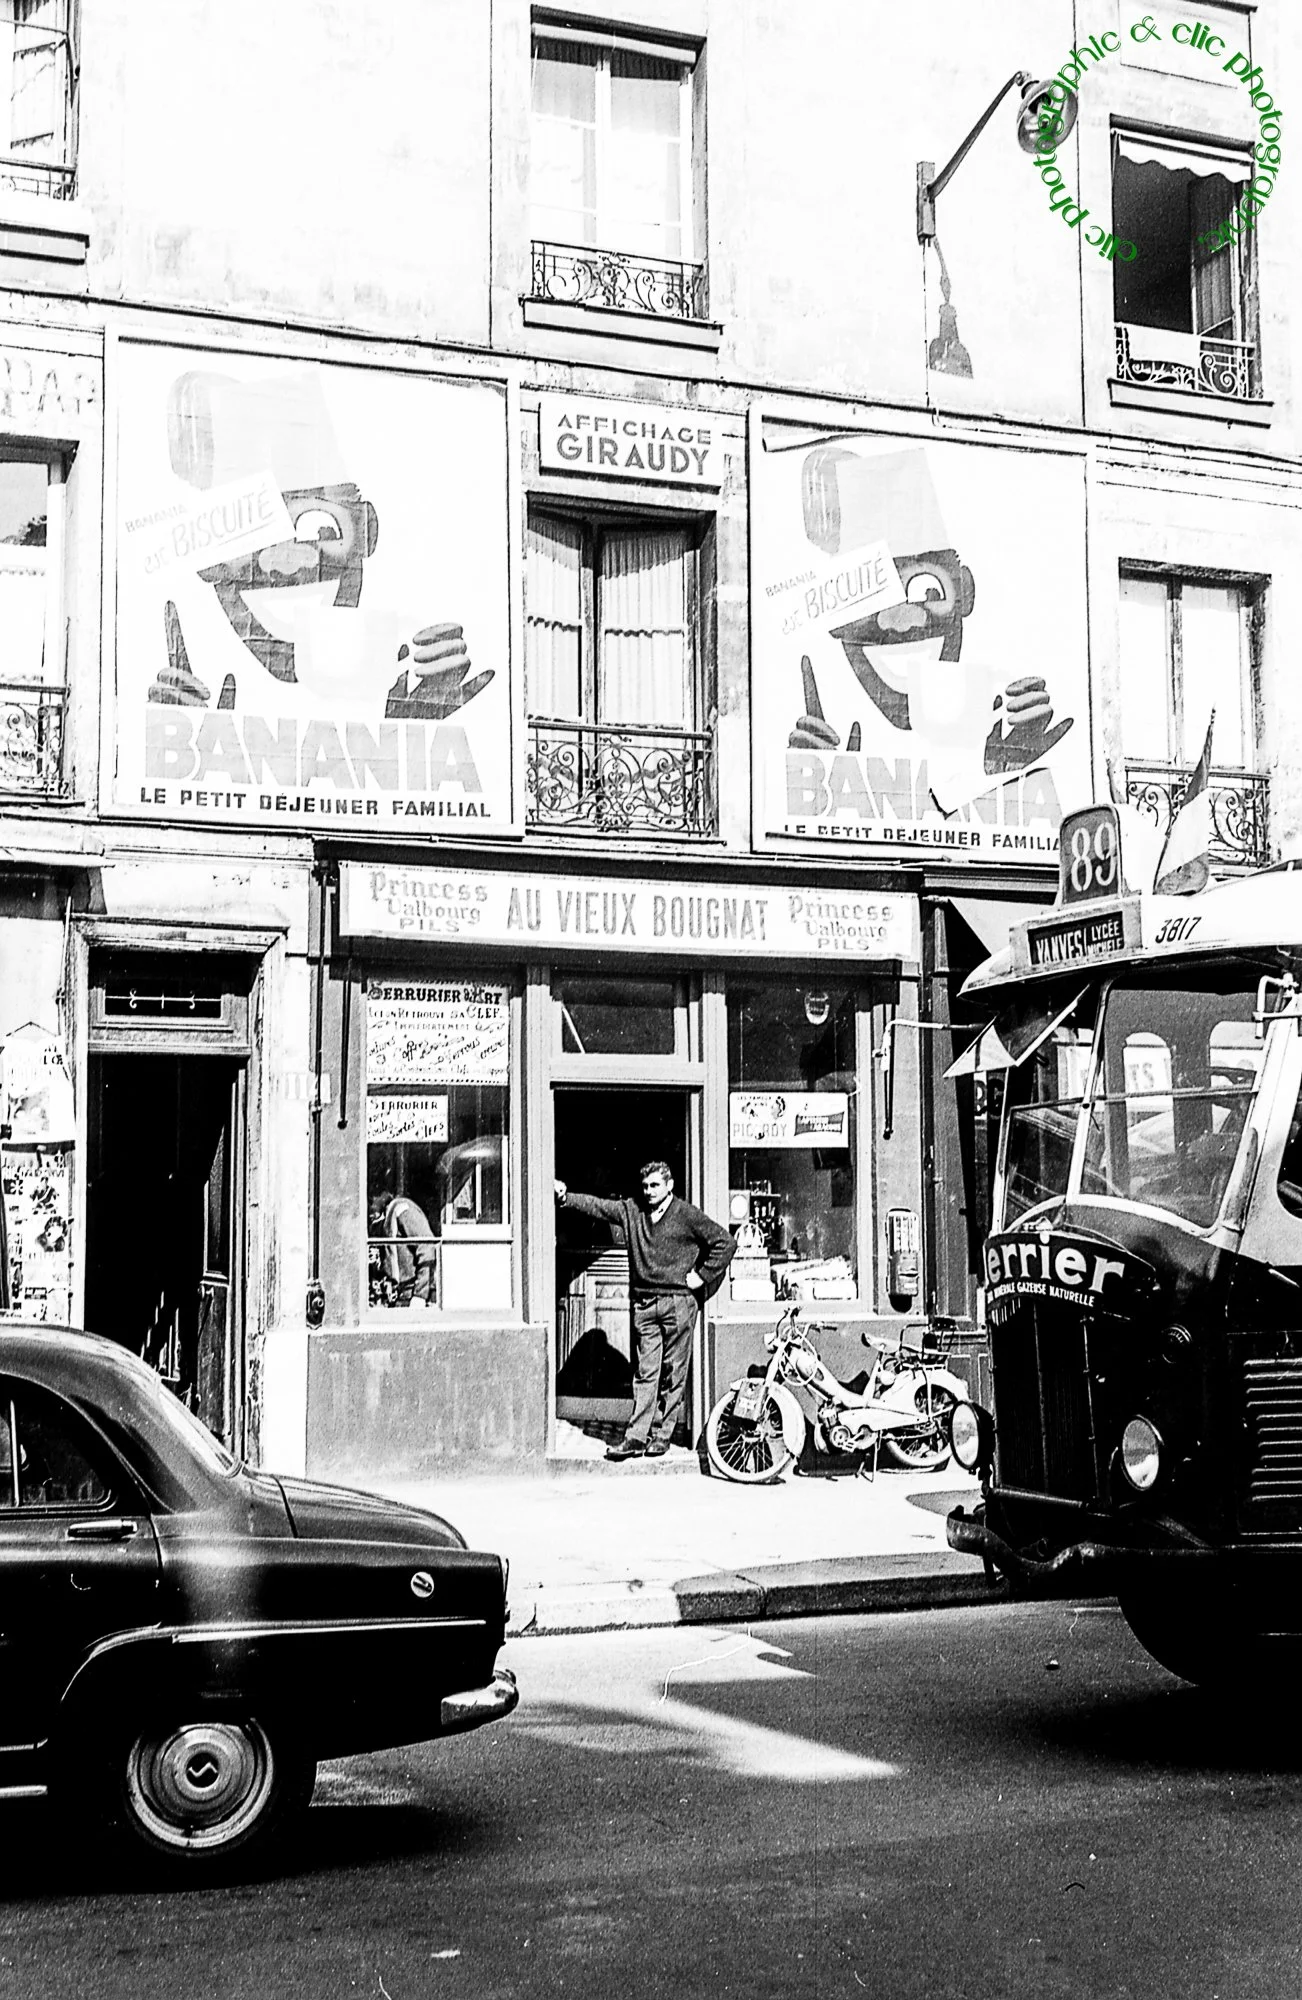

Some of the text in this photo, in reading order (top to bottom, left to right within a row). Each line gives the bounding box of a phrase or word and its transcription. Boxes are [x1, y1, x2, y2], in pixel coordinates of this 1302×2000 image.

[558, 413, 711, 445] AFFICHAGE
[557, 432, 709, 476] GIRAUDY
[171, 481, 275, 557] BISCUITÉ
[804, 551, 888, 619] BISCUITÉ
[145, 708, 483, 793] BANANIA
[140, 787, 491, 818] LE PETIT DÉJEUNER FAMILIAL
[992, 833, 1060, 851] FAMILIA
[1071, 822, 1117, 892] 89
[370, 870, 488, 902] Princess
[399, 917, 459, 932] PILS
[507, 887, 768, 941] AU VIEUX BOUGNAT
[788, 894, 894, 924] Princess
[818, 937, 870, 951] PILS
[1091, 919, 1120, 942] LYCÉE
[1155, 916, 1202, 944] 3817
[368, 982, 461, 1004] SERRURIER
[733, 1123, 787, 1138] PICRDY
[984, 1232, 1126, 1295] errier
[1049, 1285, 1095, 1308] NATURELLE
